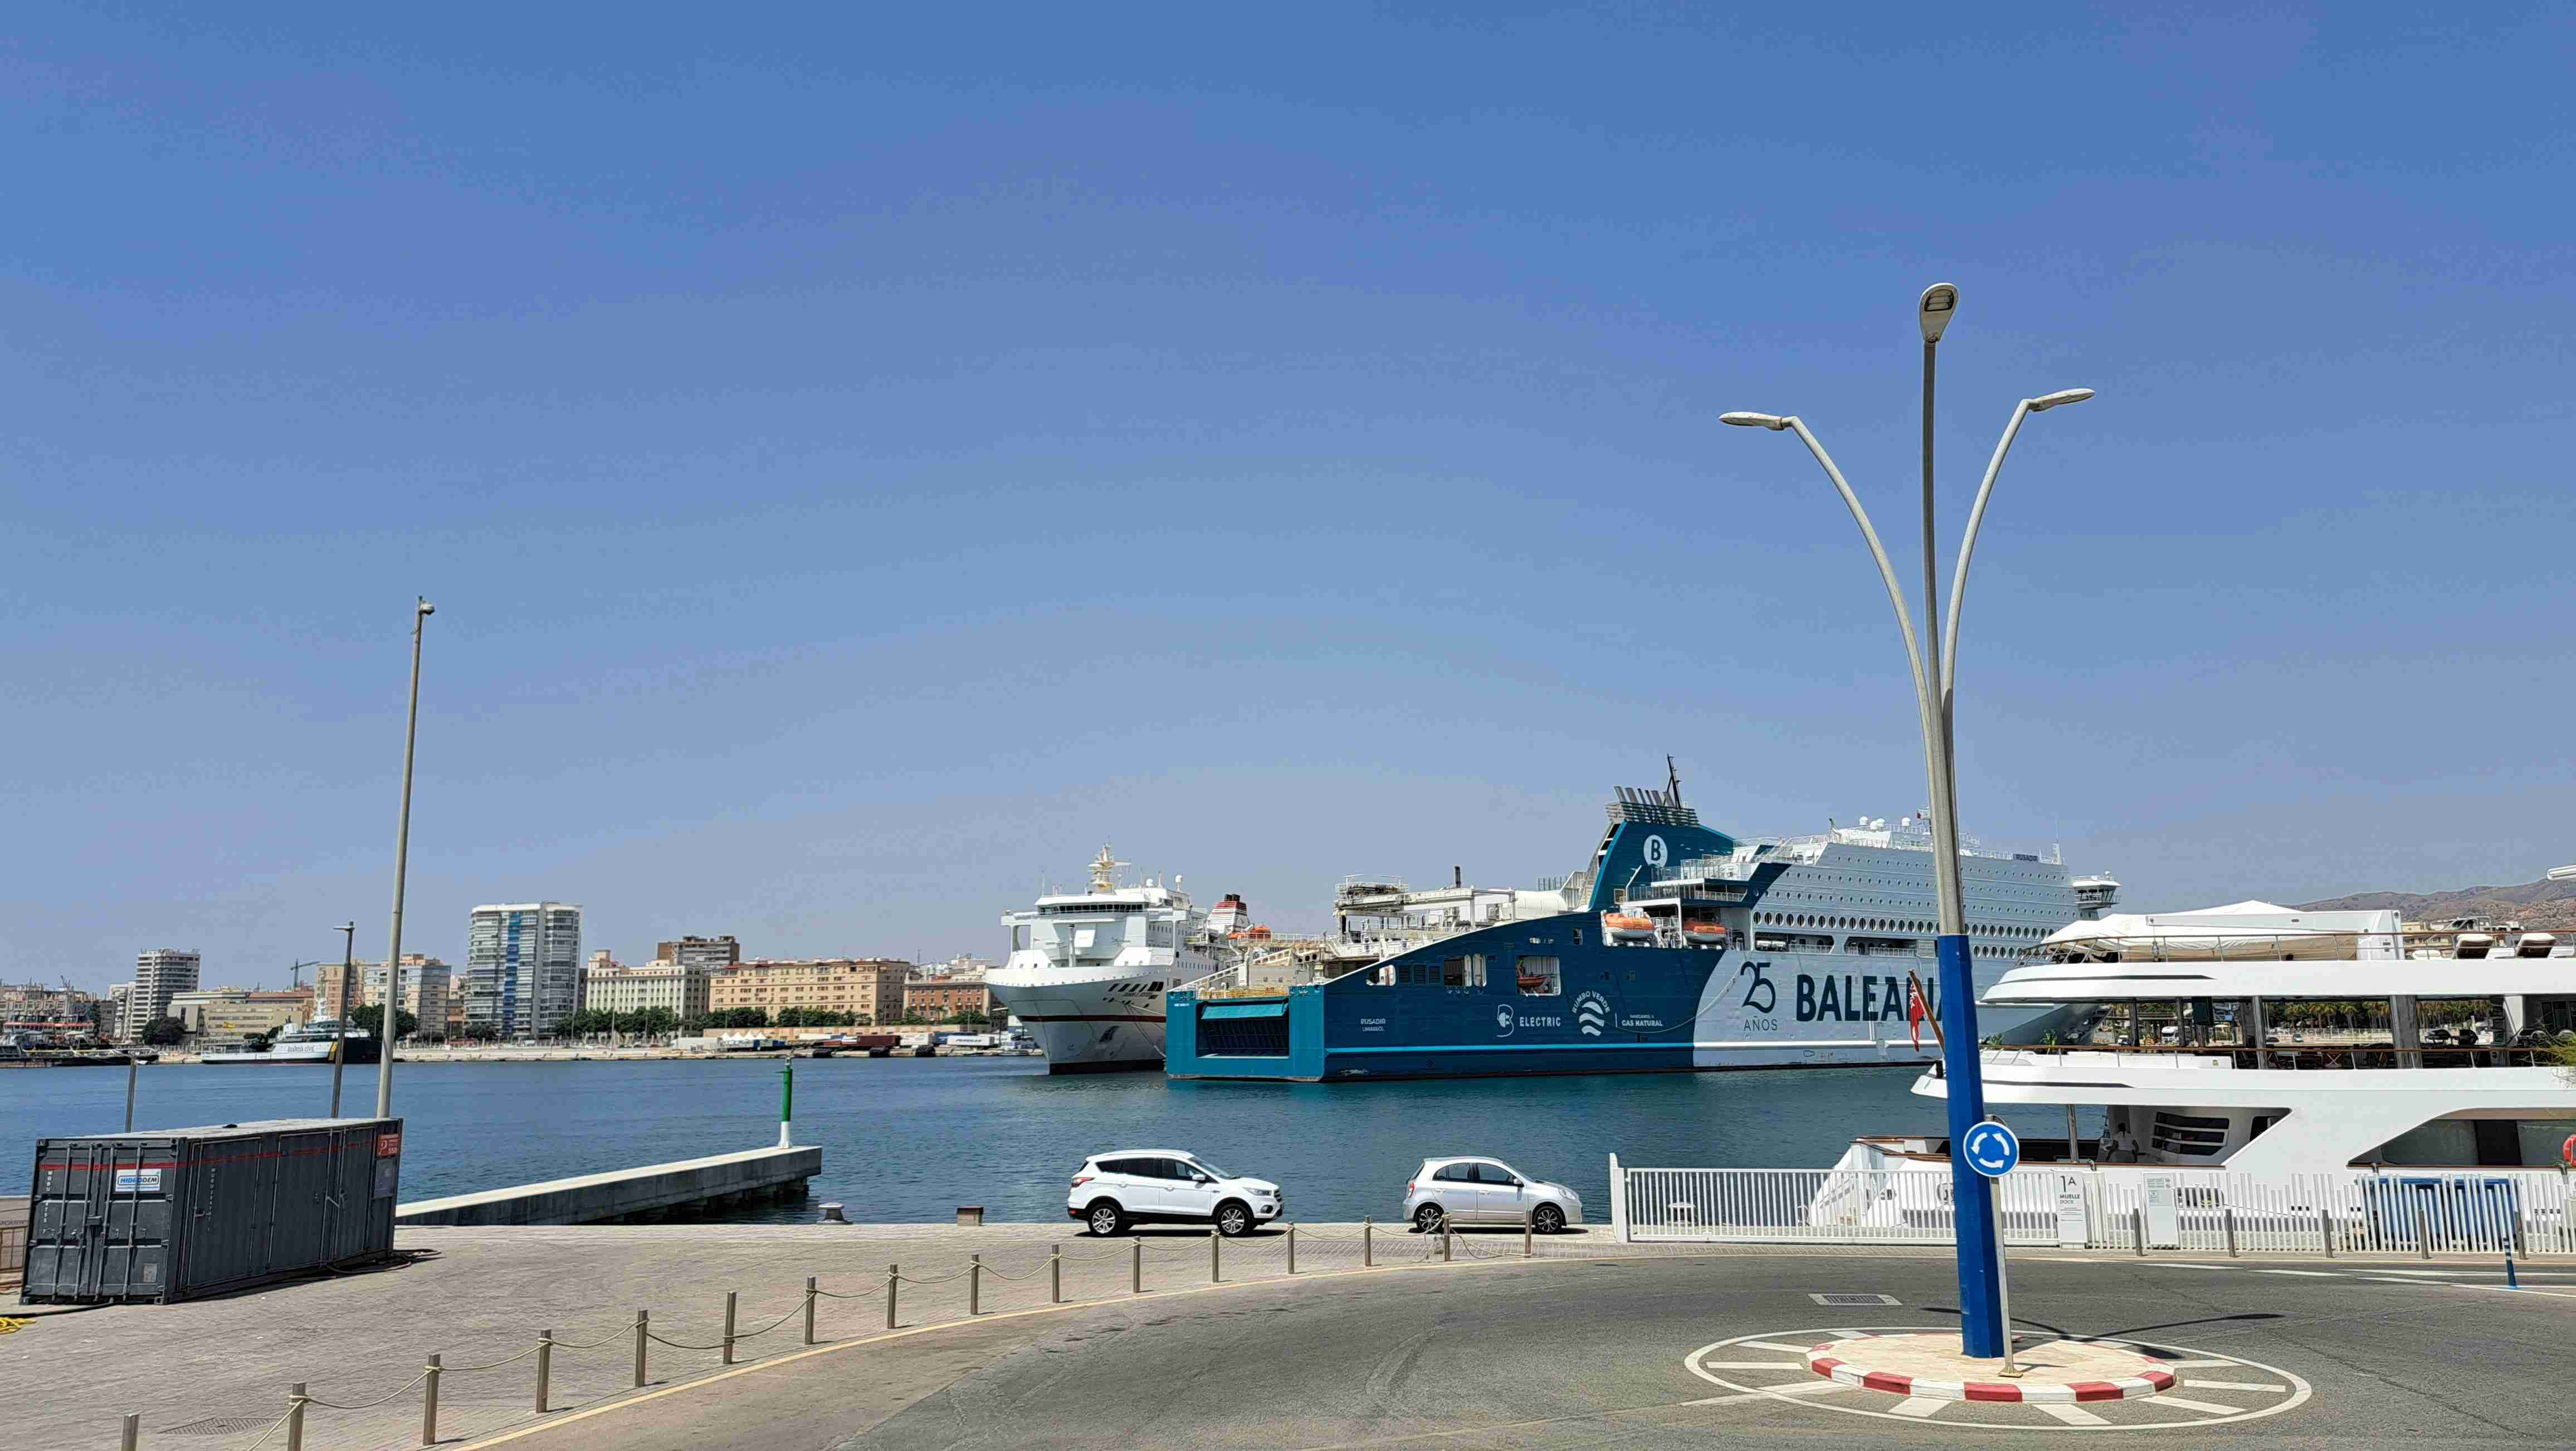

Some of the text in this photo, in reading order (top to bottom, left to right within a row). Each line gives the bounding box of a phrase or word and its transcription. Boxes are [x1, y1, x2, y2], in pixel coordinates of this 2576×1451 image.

[1651, 839, 1661, 861] B
[1740, 961, 1776, 1014] 25
[1572, 990, 1611, 1014] RUMBO VERDE
[1519, 1016, 1561, 1027] ELECTRIC
[1744, 1015, 1778, 1031] AÑOS
